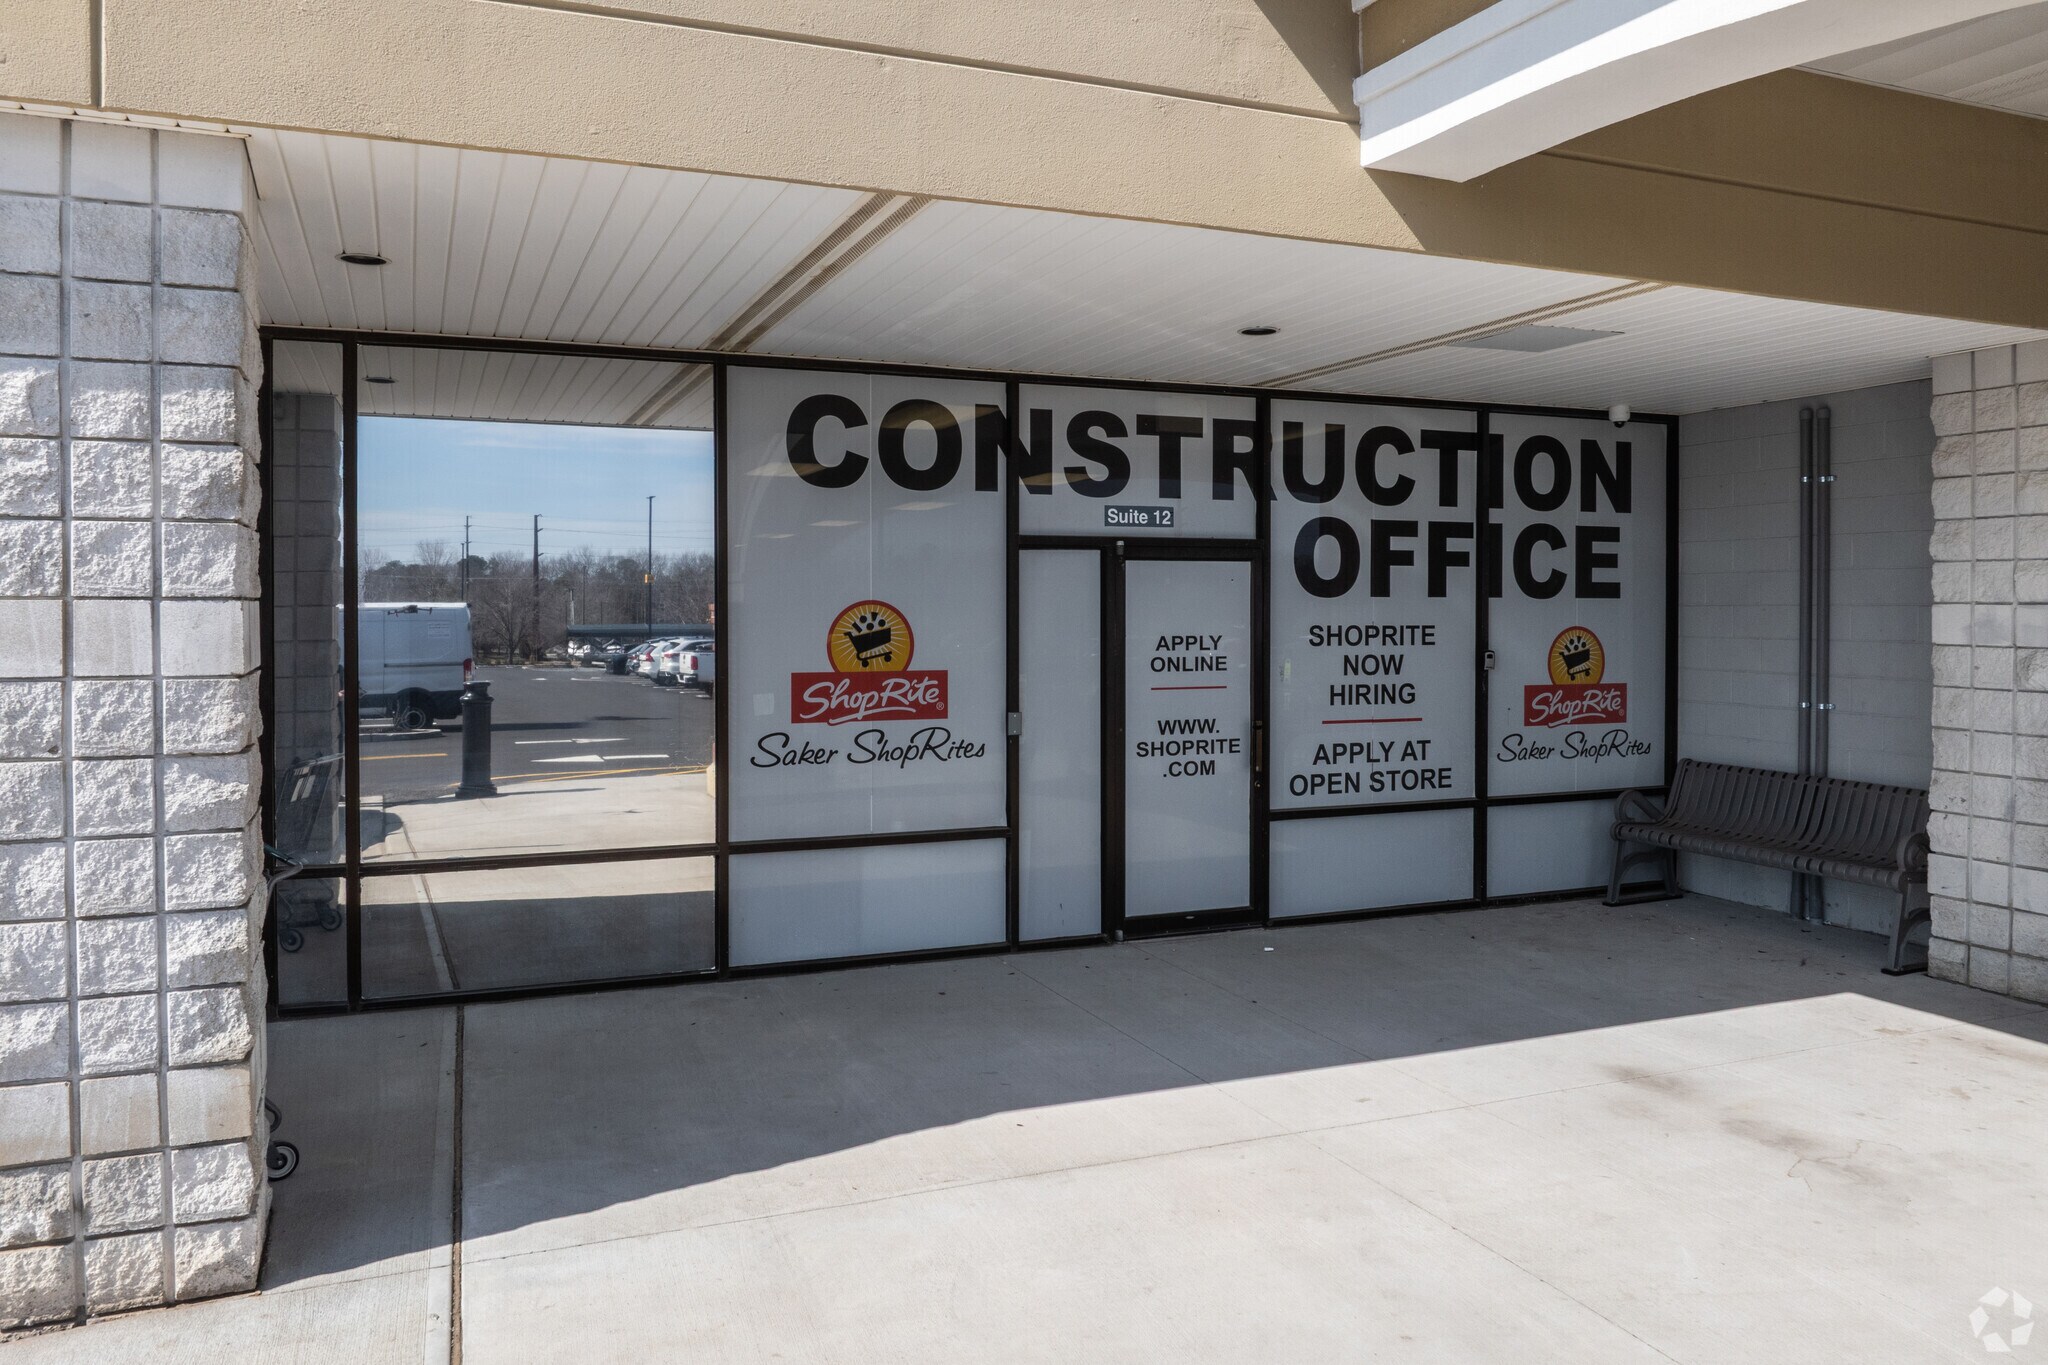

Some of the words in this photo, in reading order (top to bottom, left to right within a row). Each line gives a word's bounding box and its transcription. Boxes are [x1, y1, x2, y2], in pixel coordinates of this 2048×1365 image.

[786, 394, 1632, 514] CONSTRUCTION
[1107, 508, 1148, 524] Suite
[1153, 509, 1171, 525] 12
[1294, 516, 1621, 599] OFFICE
[1156, 635, 1222, 652] APPLY
[1309, 625, 1436, 647] SHOPRITE
[1150, 656, 1228, 673] ONLINE
[1343, 654, 1404, 676] NOW
[800, 676, 940, 722] ShopRite
[1329, 682, 1416, 706] HIRING
[1529, 688, 1622, 723] ShopRite
[1157, 718, 1220, 736] WWW.
[750, 732, 838, 768] Saker
[847, 727, 986, 769] ShopRites
[1136, 739, 1241, 757] SHOPRITE
[1312, 741, 1396, 766] APPLY
[1400, 739, 1432, 762] AT
[1497, 733, 1555, 762] Saker
[1560, 729, 1652, 763] ShopRites
[1163, 760, 1216, 778] .COM
[1289, 772, 1360, 797] OPEN
[1369, 767, 1453, 793] STORE
